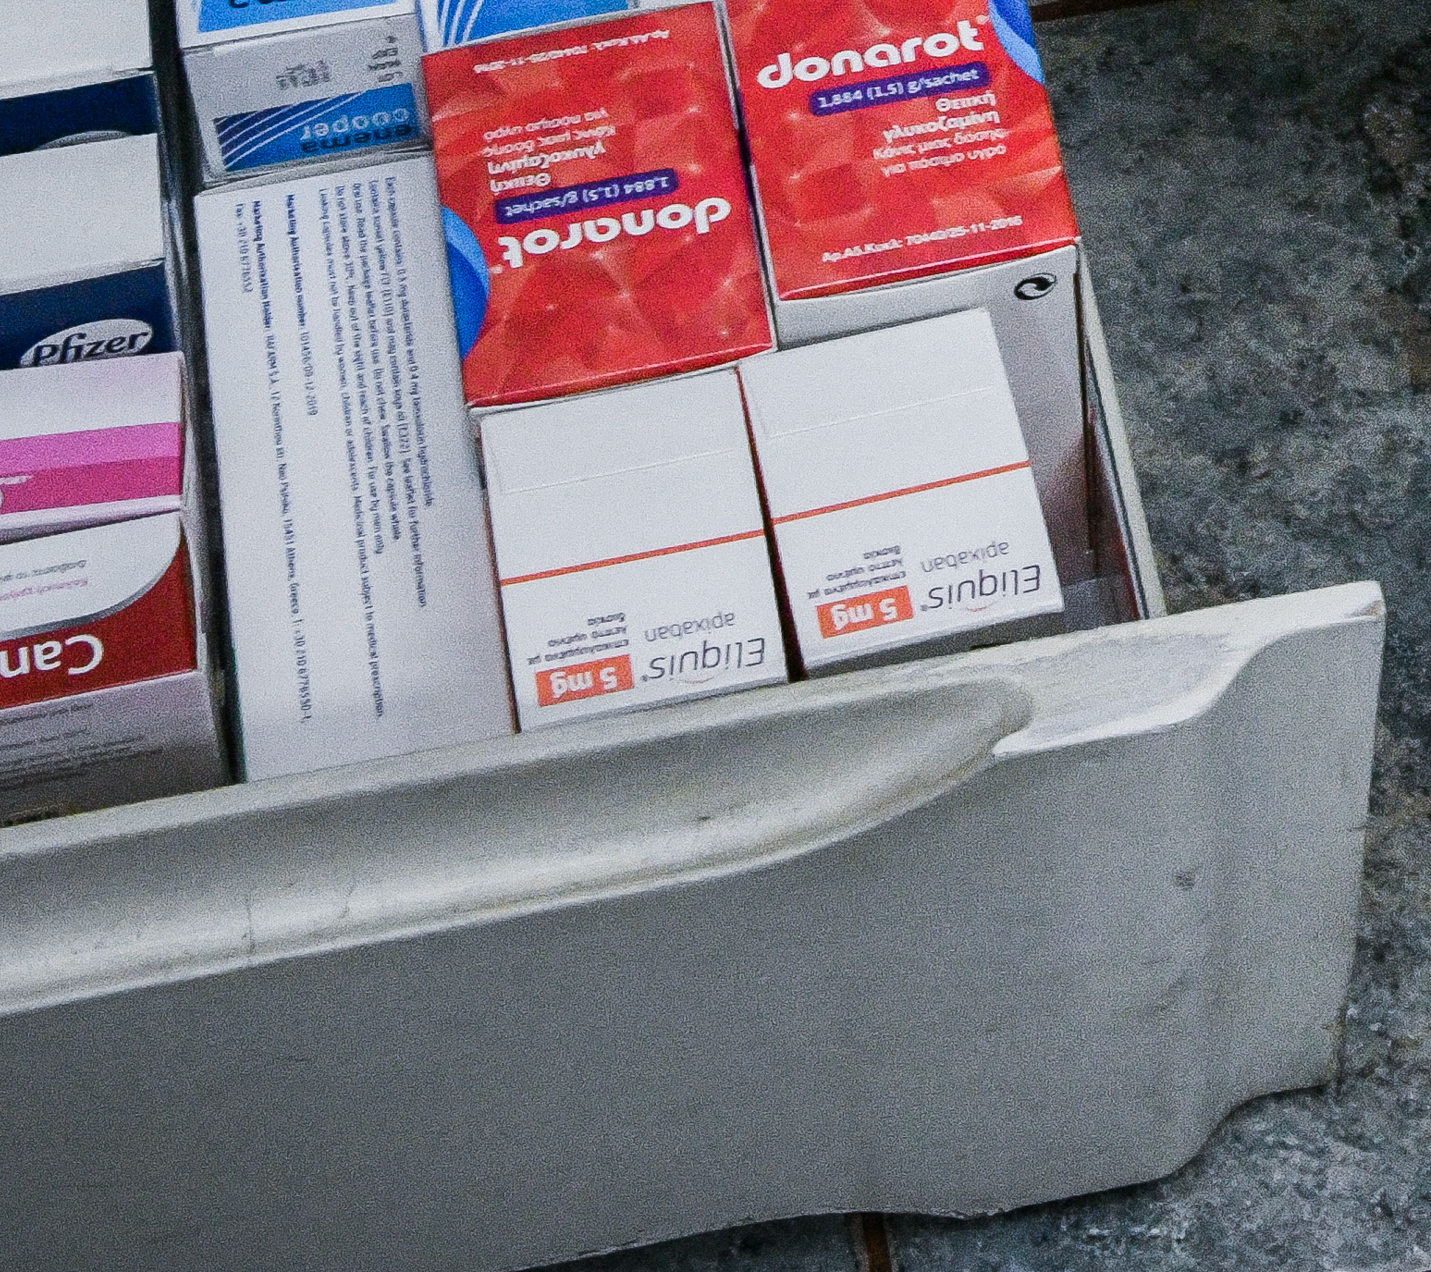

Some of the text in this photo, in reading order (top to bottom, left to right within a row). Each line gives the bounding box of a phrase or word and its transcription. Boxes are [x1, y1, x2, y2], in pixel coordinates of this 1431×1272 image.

[757, 19, 984, 89] donarot
[907, 68, 979, 93] g/sachet
[300, 123, 412, 153] enema
[301, 112, 410, 140] cooper
[505, 190, 579, 217] g/sachet
[498, 197, 731, 269] donarot
[29, 333, 152, 367] Pfizer
[920, 540, 1010, 574] apixaban
[830, 563, 1042, 631] Eliquis 5 mg
[643, 611, 736, 643] apixaban
[549, 636, 766, 698] Eliquis 5 mg
